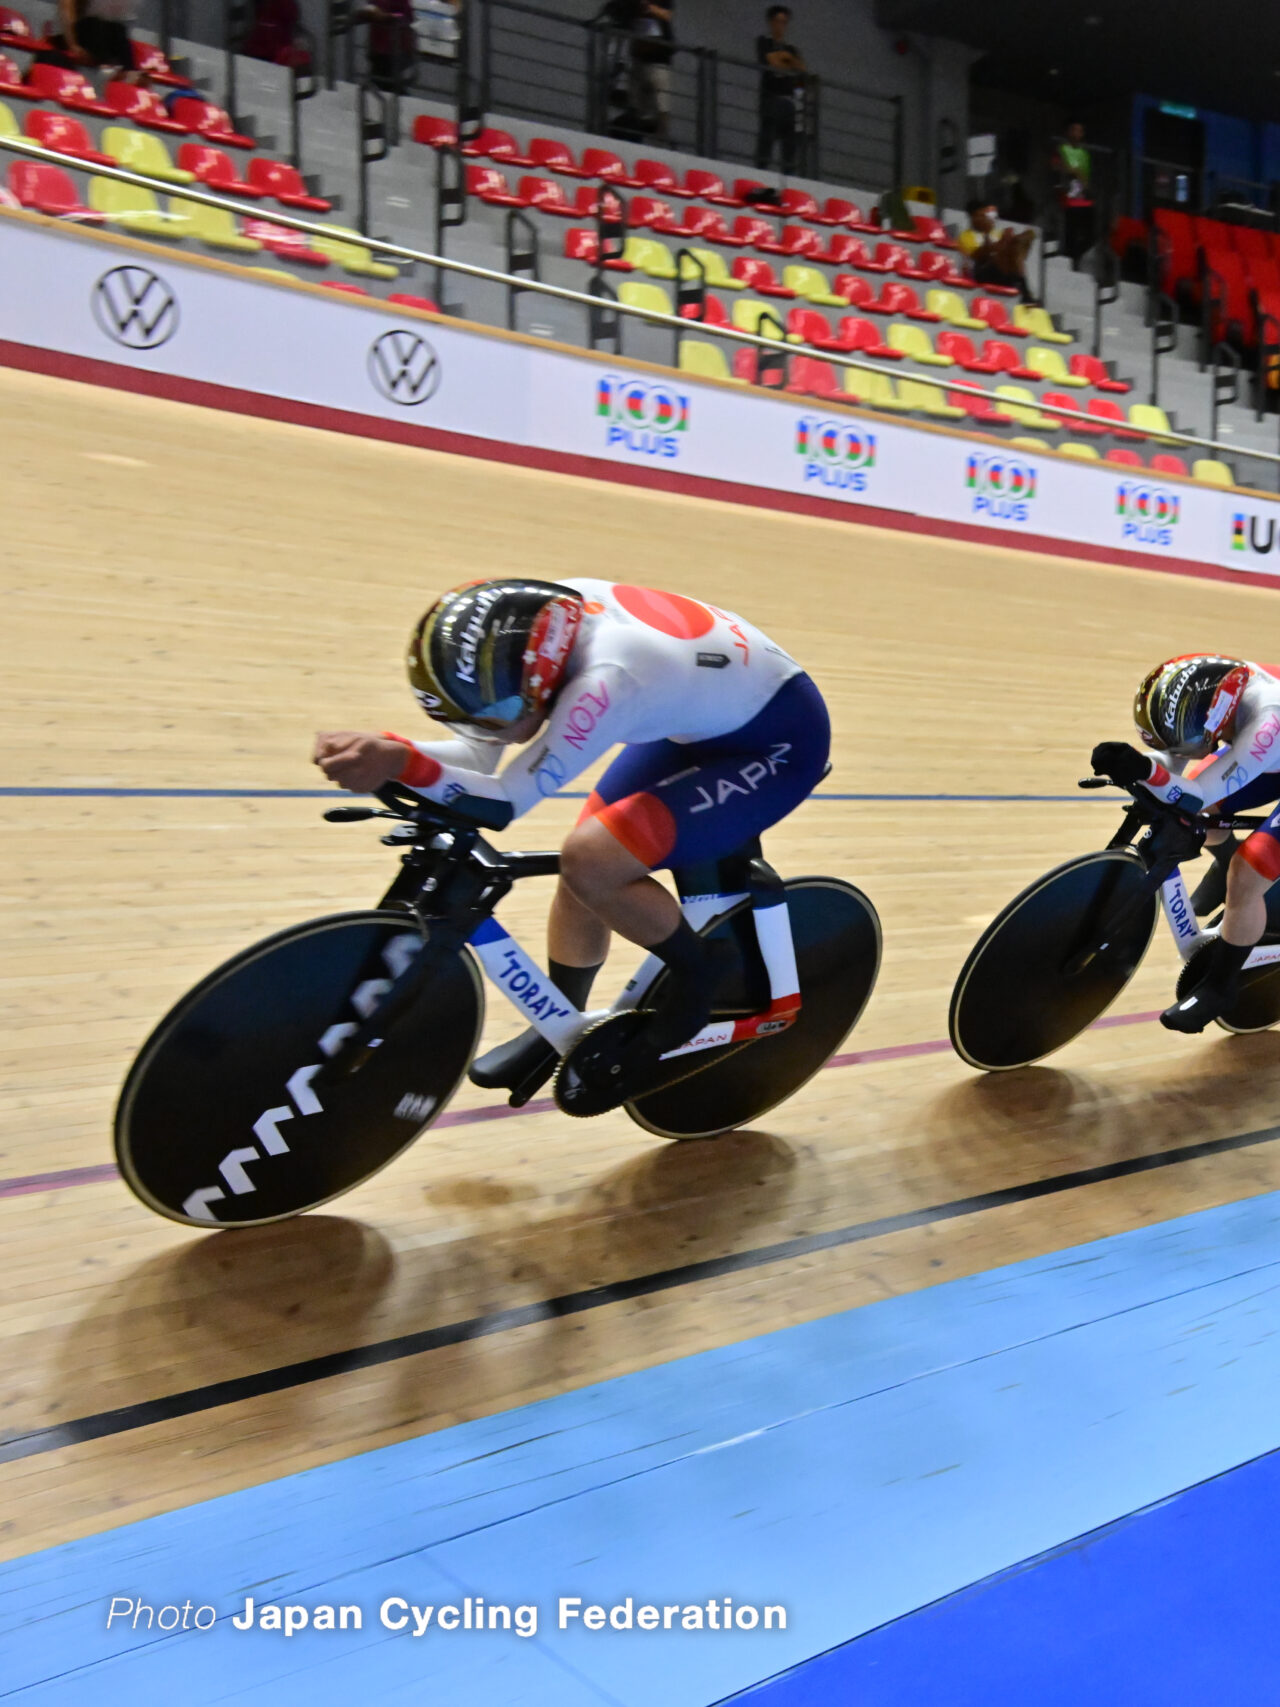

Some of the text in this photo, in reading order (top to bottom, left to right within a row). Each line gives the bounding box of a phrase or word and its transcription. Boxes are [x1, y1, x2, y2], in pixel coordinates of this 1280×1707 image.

[606, 425, 680, 458] PLUS
[803, 463, 867, 492] PLUS
[972, 495, 1029, 522] PLUS
[1121, 522, 1173, 546] PLUS
[1164, 664, 1197, 729] Kabuto
[690, 742, 792, 813] JAPAN
[681, 1034, 728, 1049] APAN
